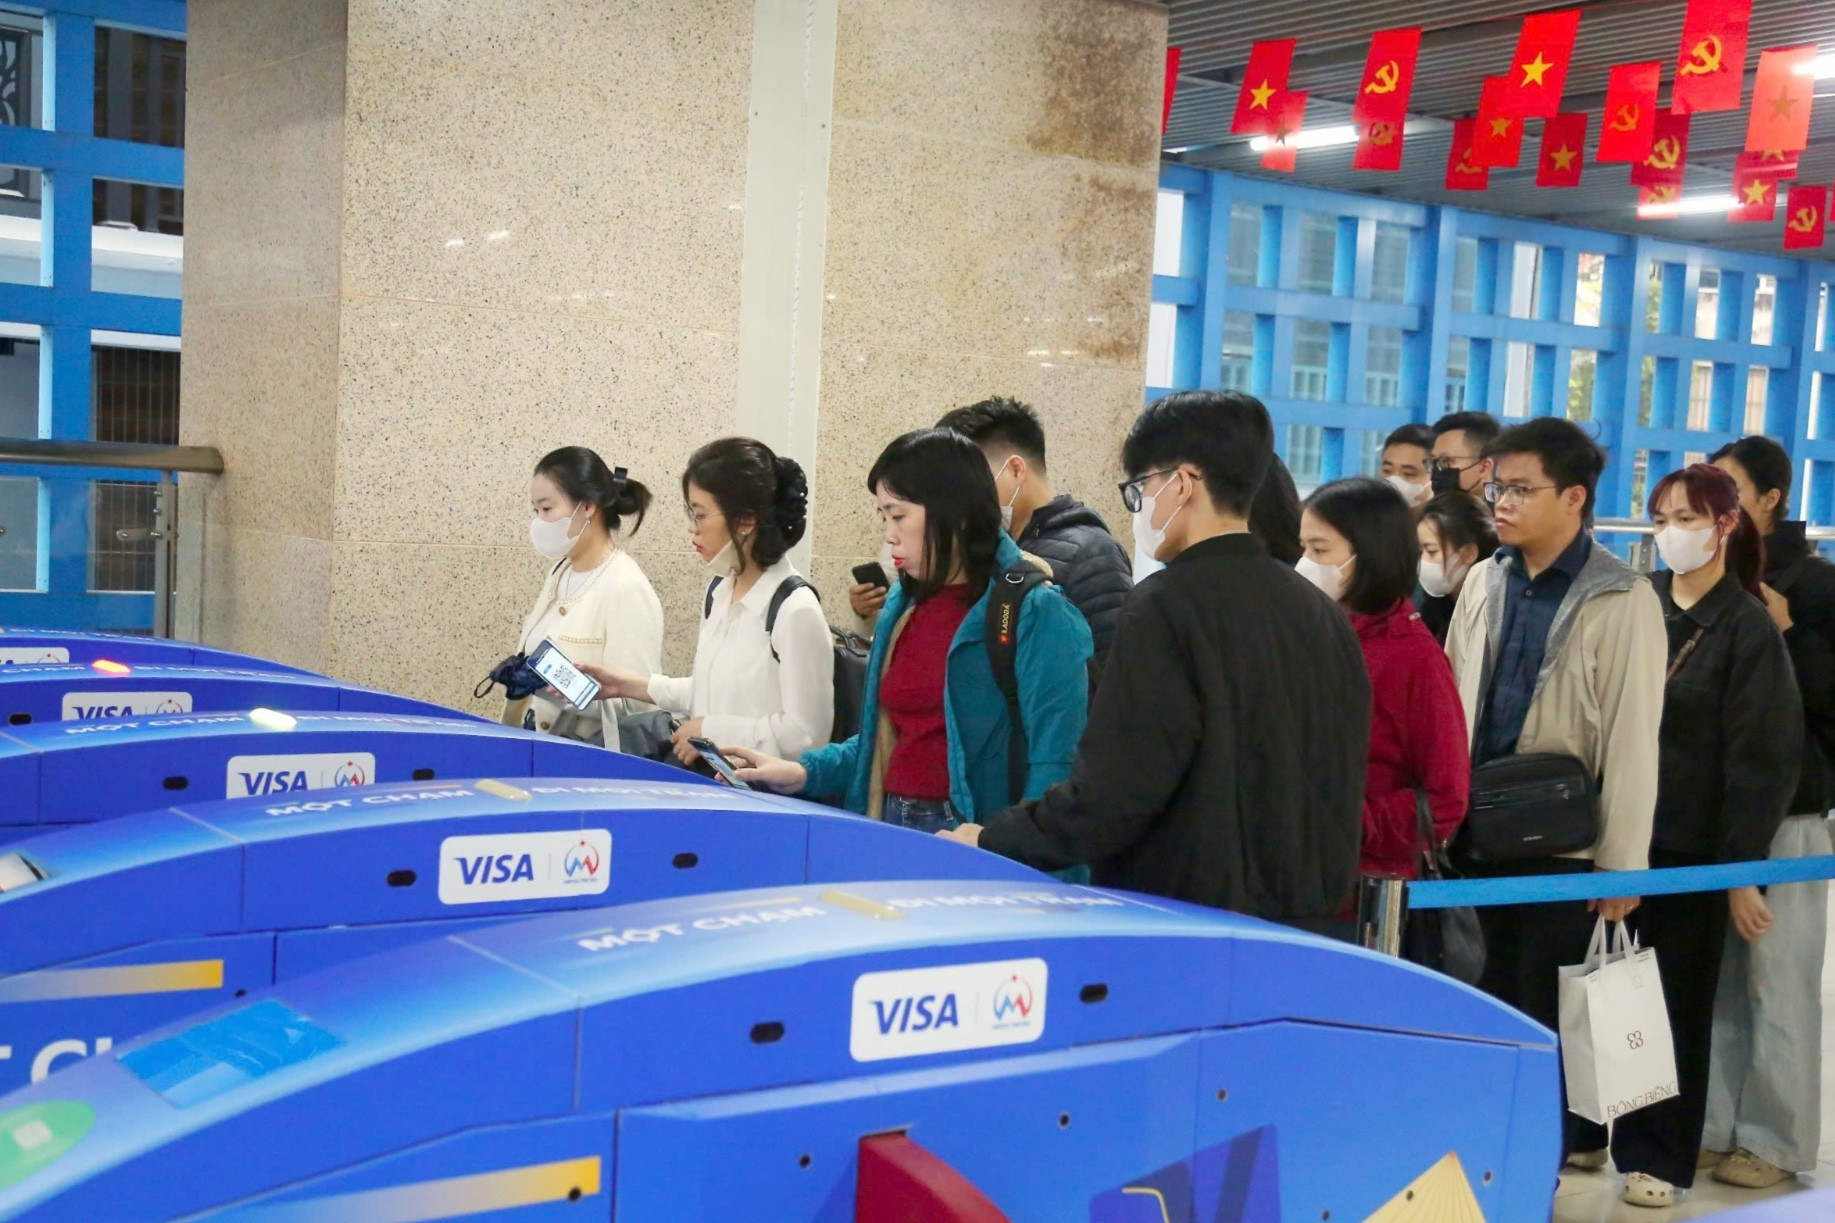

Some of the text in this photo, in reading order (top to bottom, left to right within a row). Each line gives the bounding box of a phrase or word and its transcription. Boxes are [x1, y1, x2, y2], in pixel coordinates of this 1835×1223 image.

[237, 770, 309, 796] VISA
[453, 853, 534, 885] VISA
[869, 993, 959, 1035] VISA
